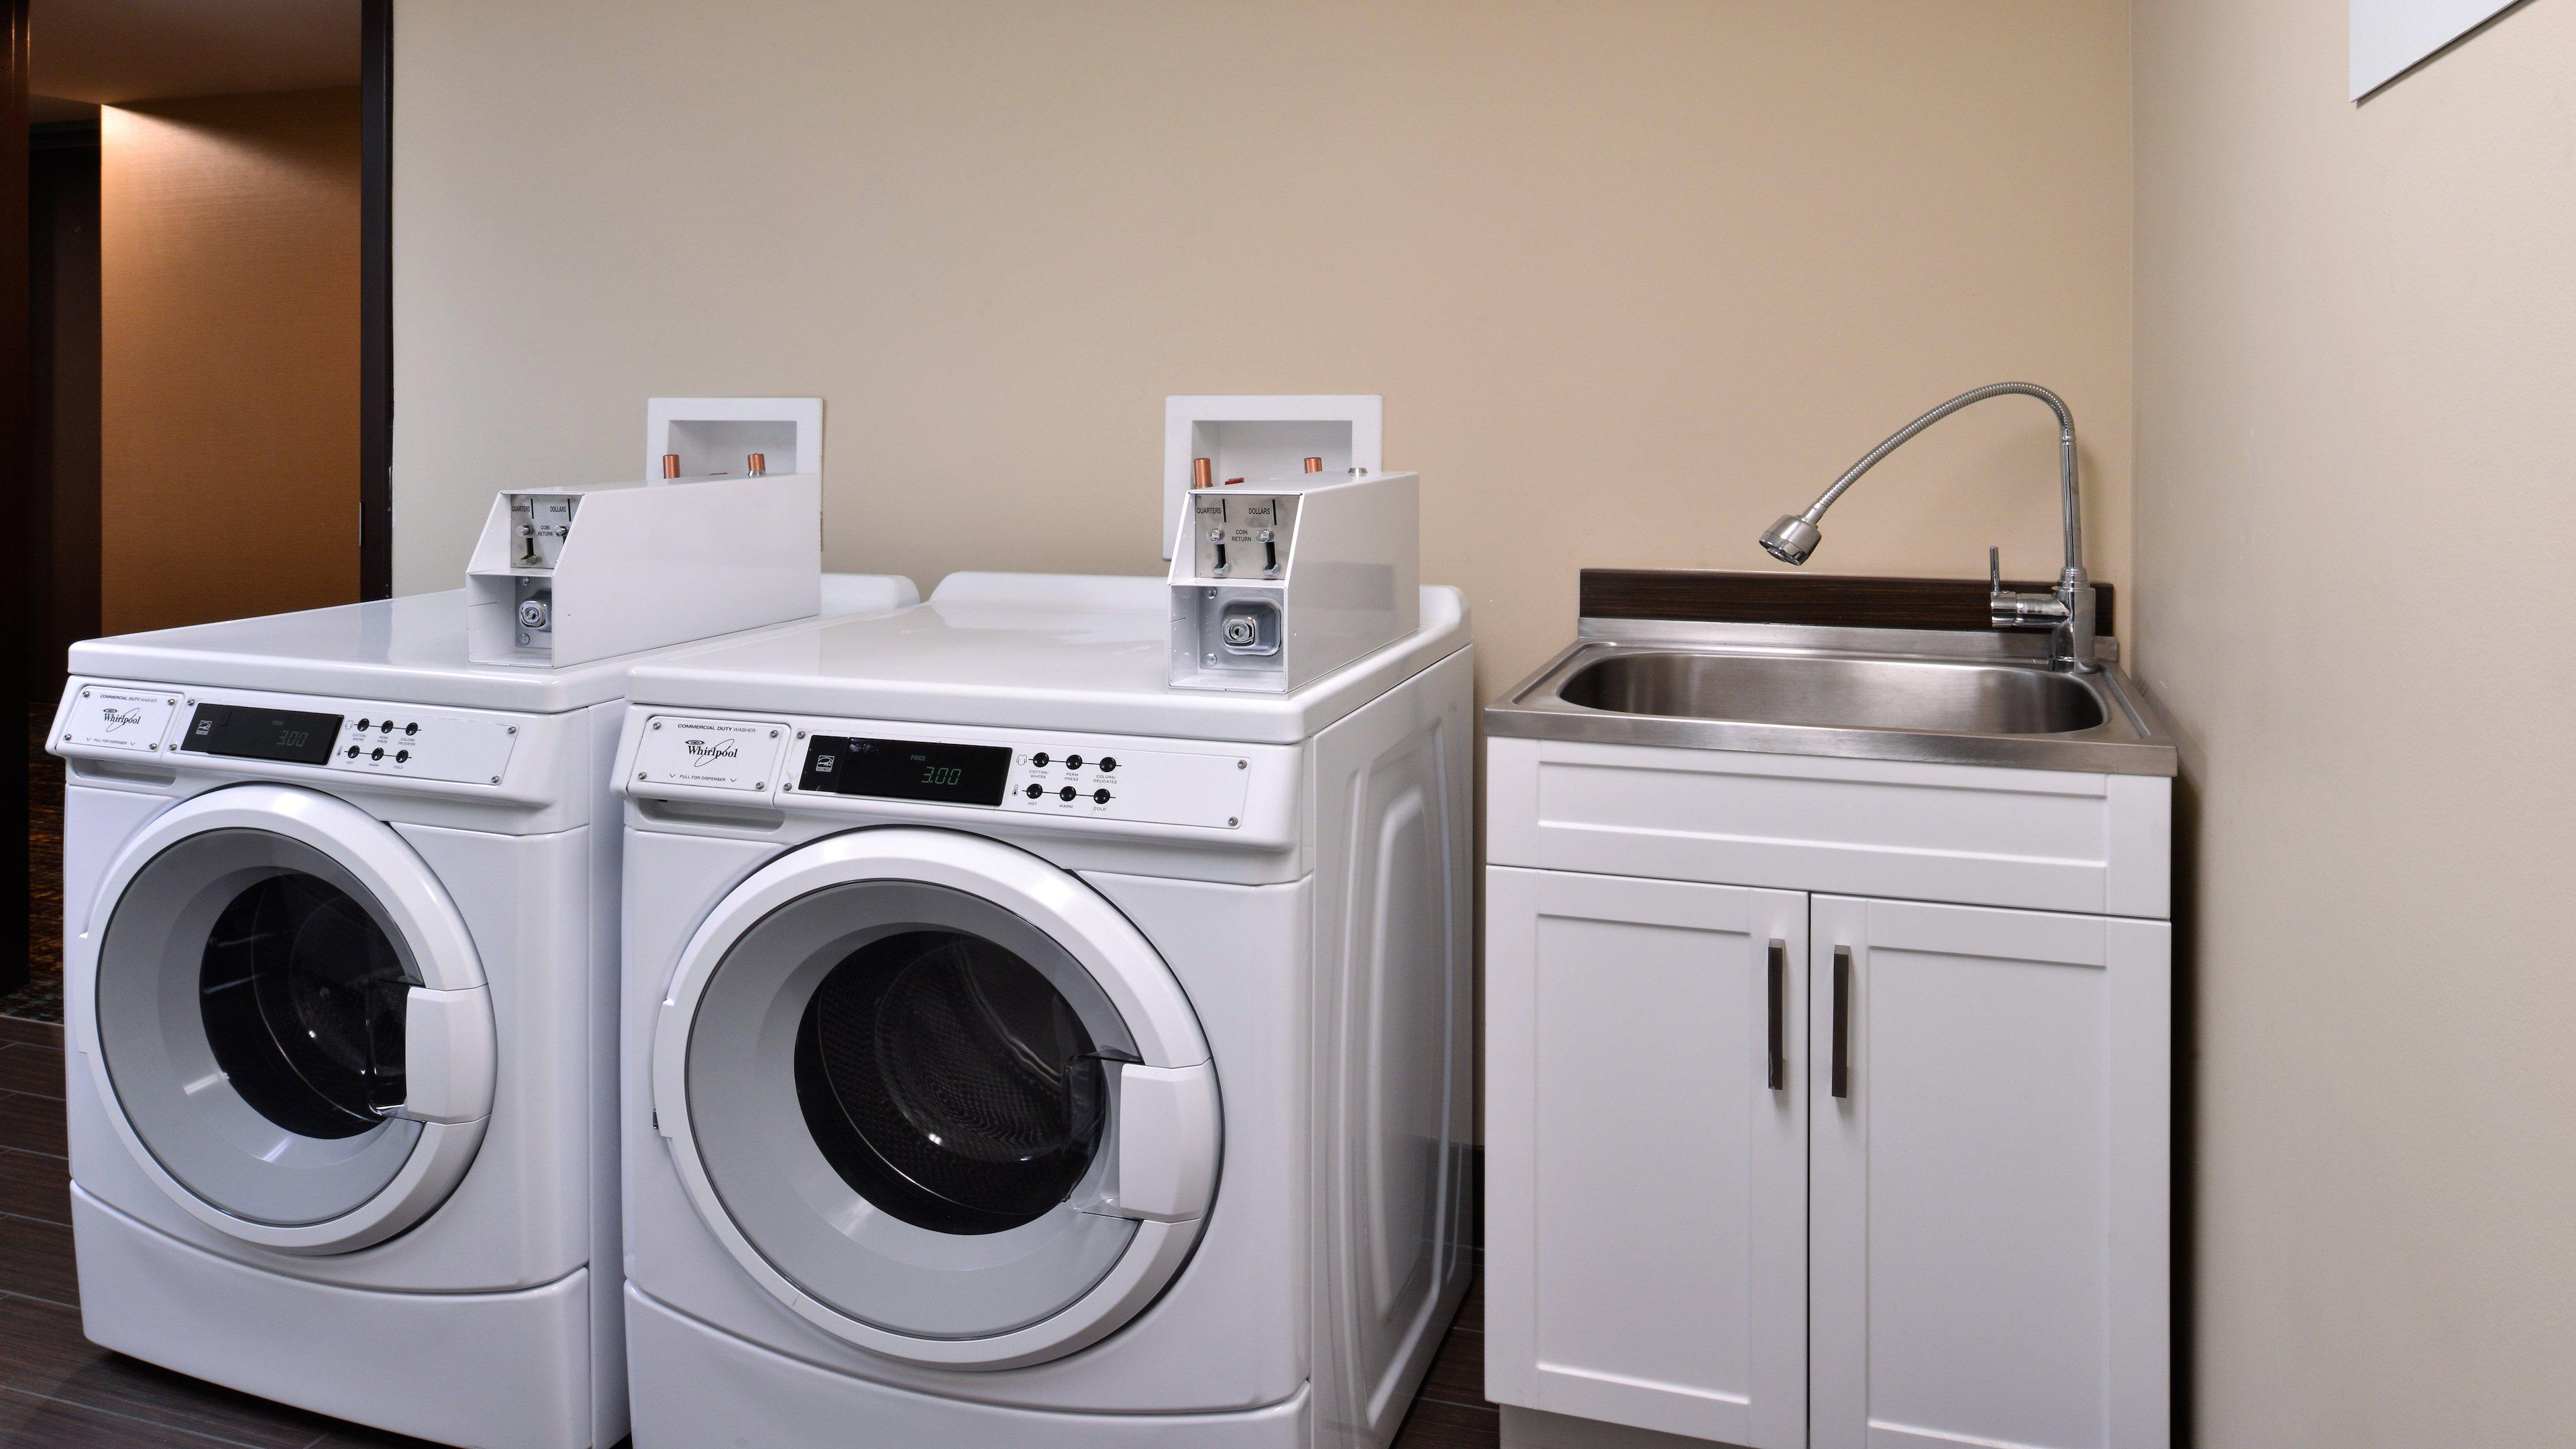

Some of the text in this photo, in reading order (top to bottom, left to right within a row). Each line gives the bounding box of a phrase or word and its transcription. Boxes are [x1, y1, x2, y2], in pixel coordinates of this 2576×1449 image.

[104, 713, 142, 725] Whirlpool
[276, 730, 309, 747] 3.00
[688, 745, 738, 759] Whirlpool
[921, 767, 962, 785] 3.00
